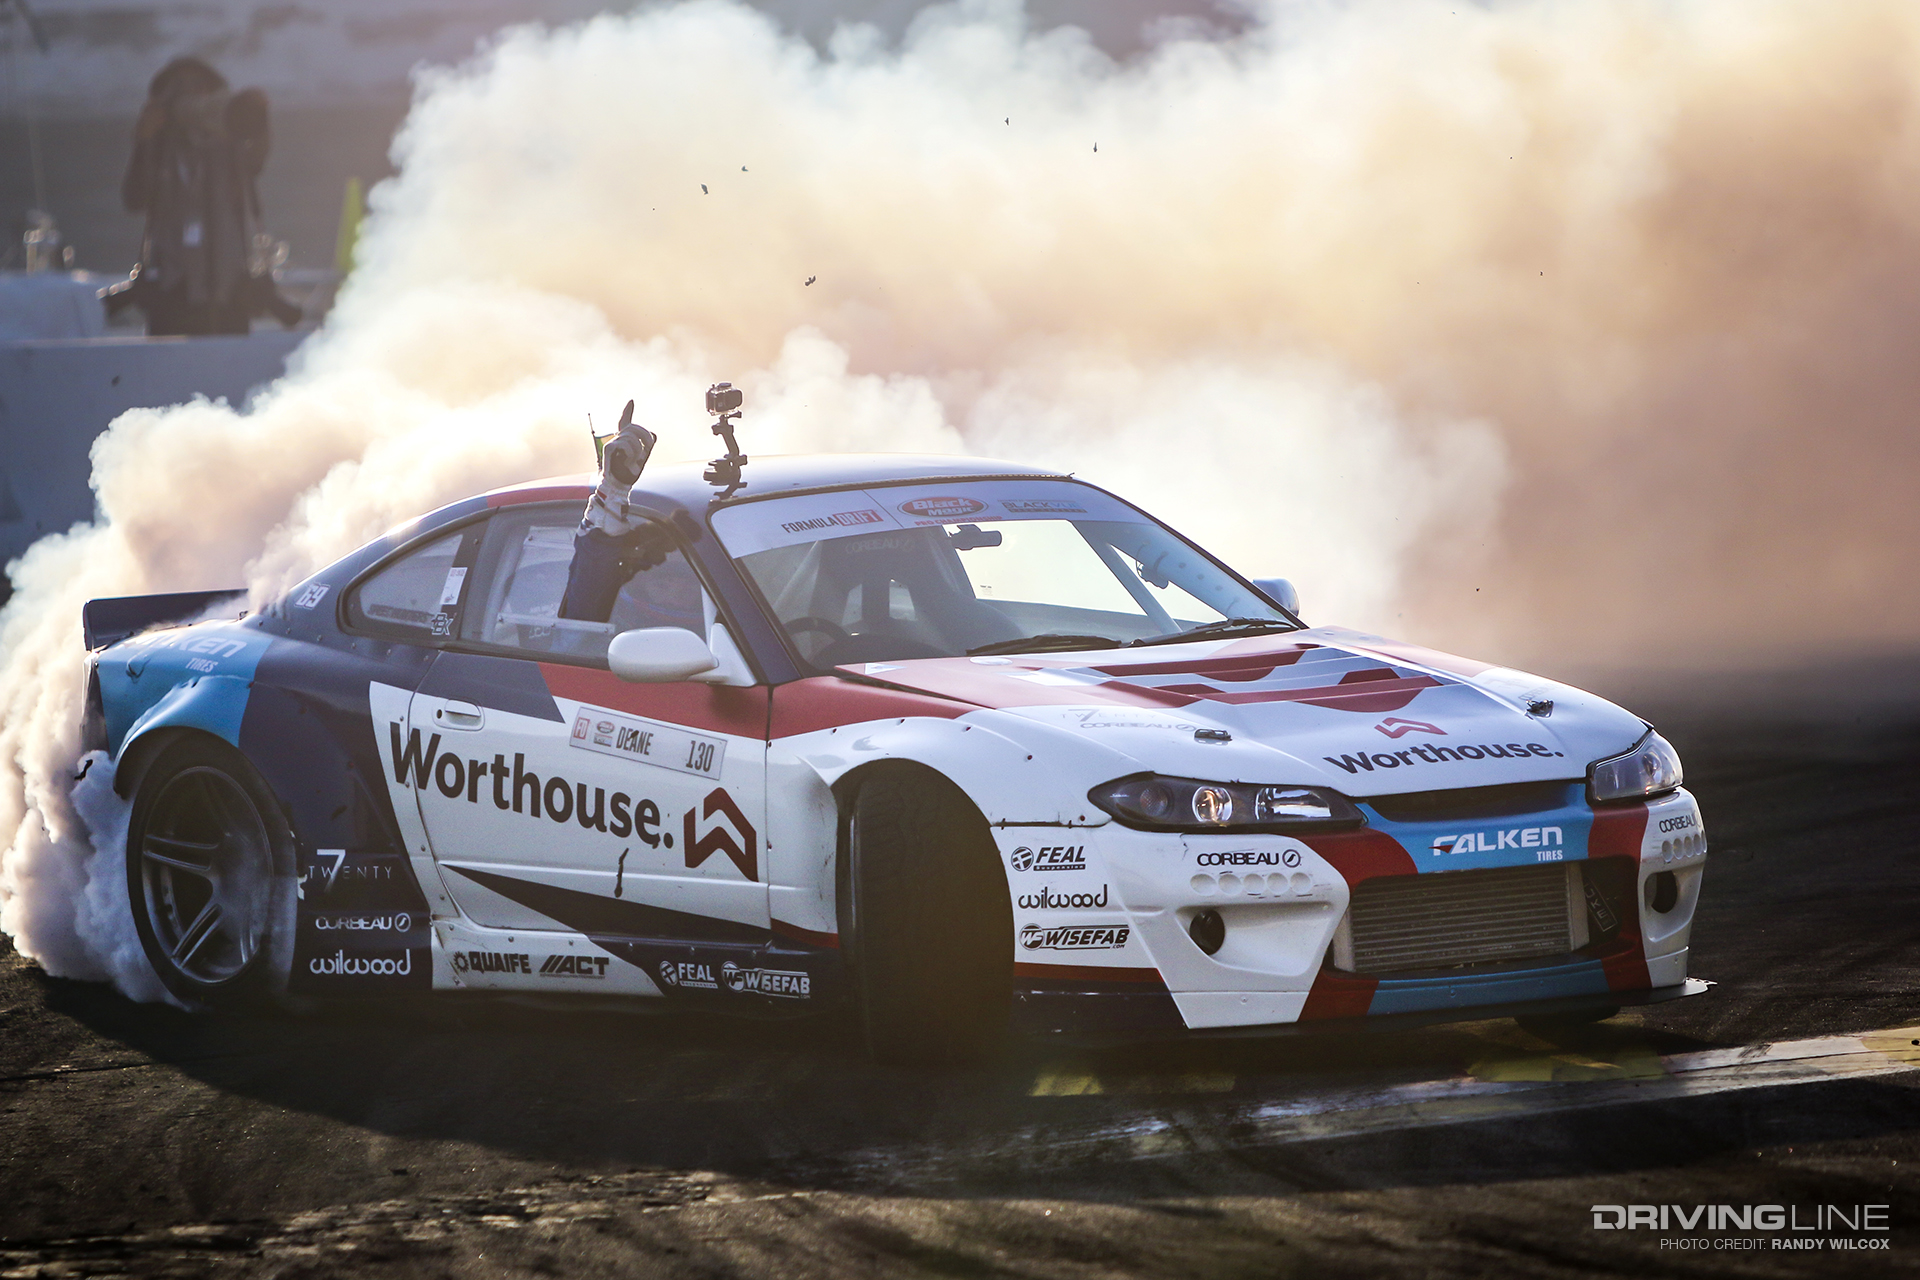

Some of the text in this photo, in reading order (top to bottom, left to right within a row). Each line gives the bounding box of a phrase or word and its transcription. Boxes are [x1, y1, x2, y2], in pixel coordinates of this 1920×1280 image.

[781, 510, 882, 533] FORMULA DRIFT
[616, 726, 654, 756] DEANE
[686, 740, 715, 772] 130
[1324, 739, 1564, 774] Worthouse.
[390, 720, 674, 849] Worthouse.
[1659, 813, 1696, 833] CORBEAU
[1430, 826, 1563, 856] FALKEN
[1036, 846, 1086, 863] FEAL
[1197, 852, 1279, 867] CORBEAU
[1537, 850, 1563, 861] TIRES
[309, 866, 392, 879] TWENTY
[1018, 884, 1107, 909] wilwood
[315, 916, 392, 930] CORBEAU
[1045, 928, 1130, 946] WISEFAB
[310, 949, 411, 976] wilwood
[469, 951, 532, 974] QUAIFE
[678, 962, 716, 982] FEAL
[745, 970, 811, 995] WISEFAB
